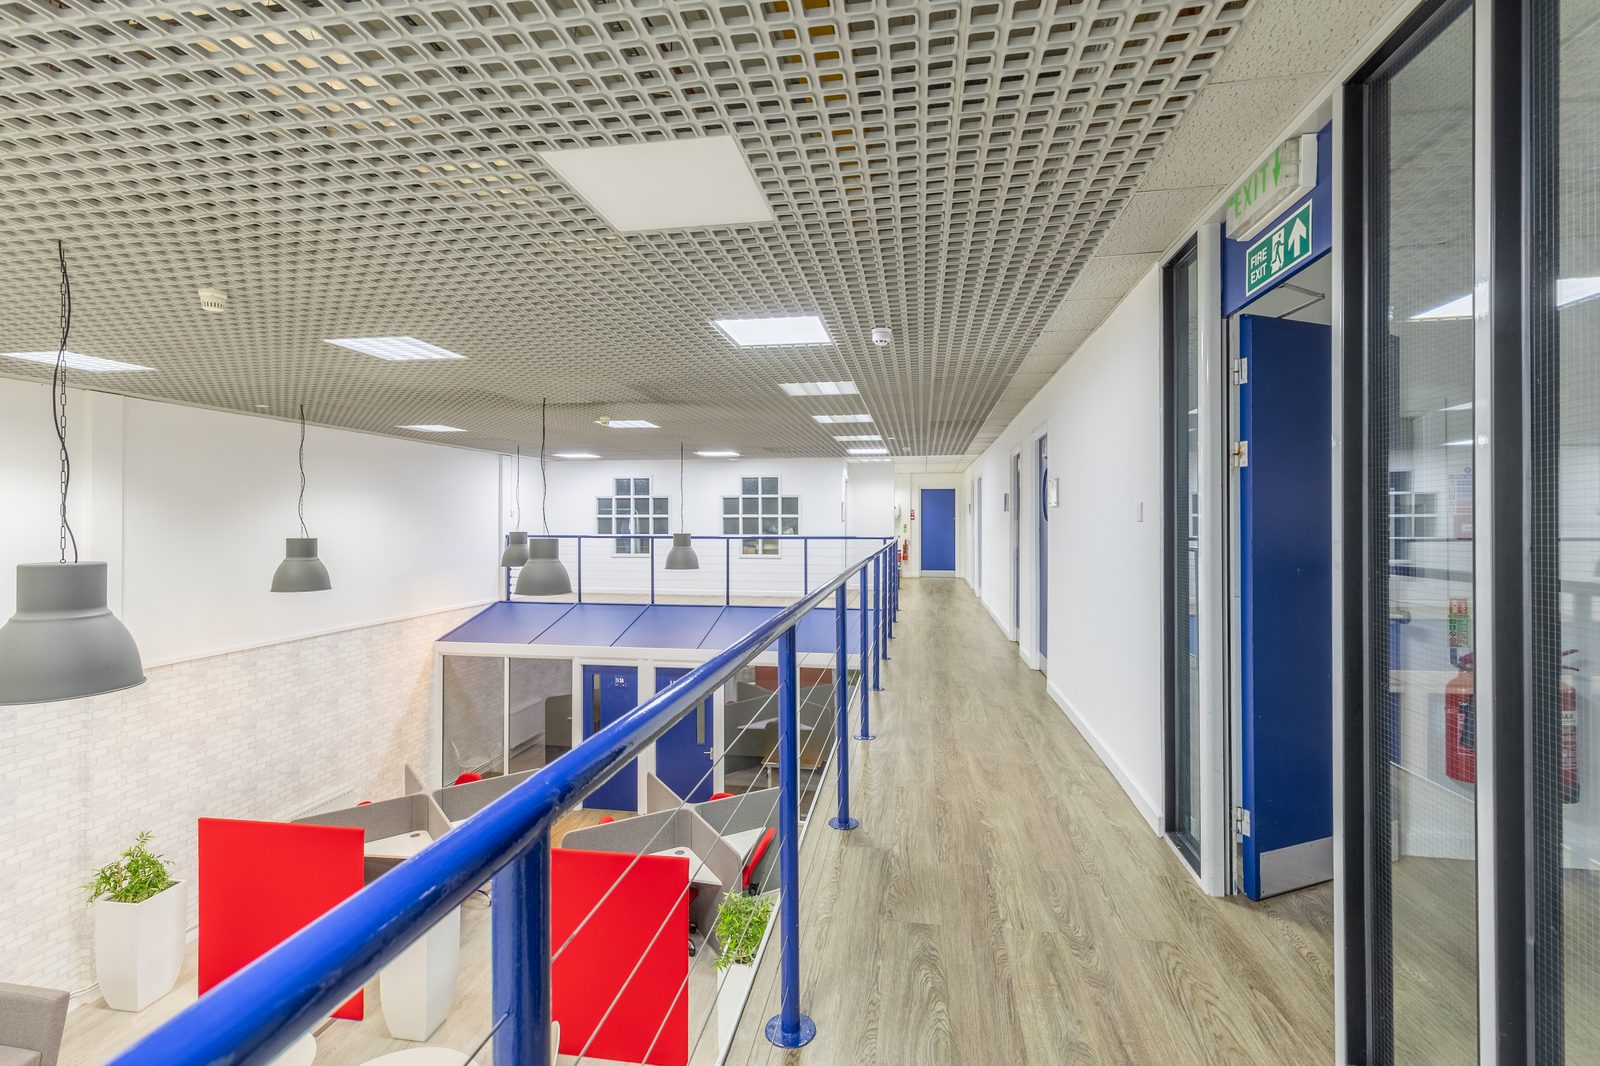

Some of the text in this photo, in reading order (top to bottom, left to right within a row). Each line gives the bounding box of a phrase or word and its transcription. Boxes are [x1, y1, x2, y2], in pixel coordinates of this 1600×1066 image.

[1234, 162, 1268, 218] EXIT
[1250, 246, 1268, 270] FIRE
[1250, 262, 1267, 285] EXIT
